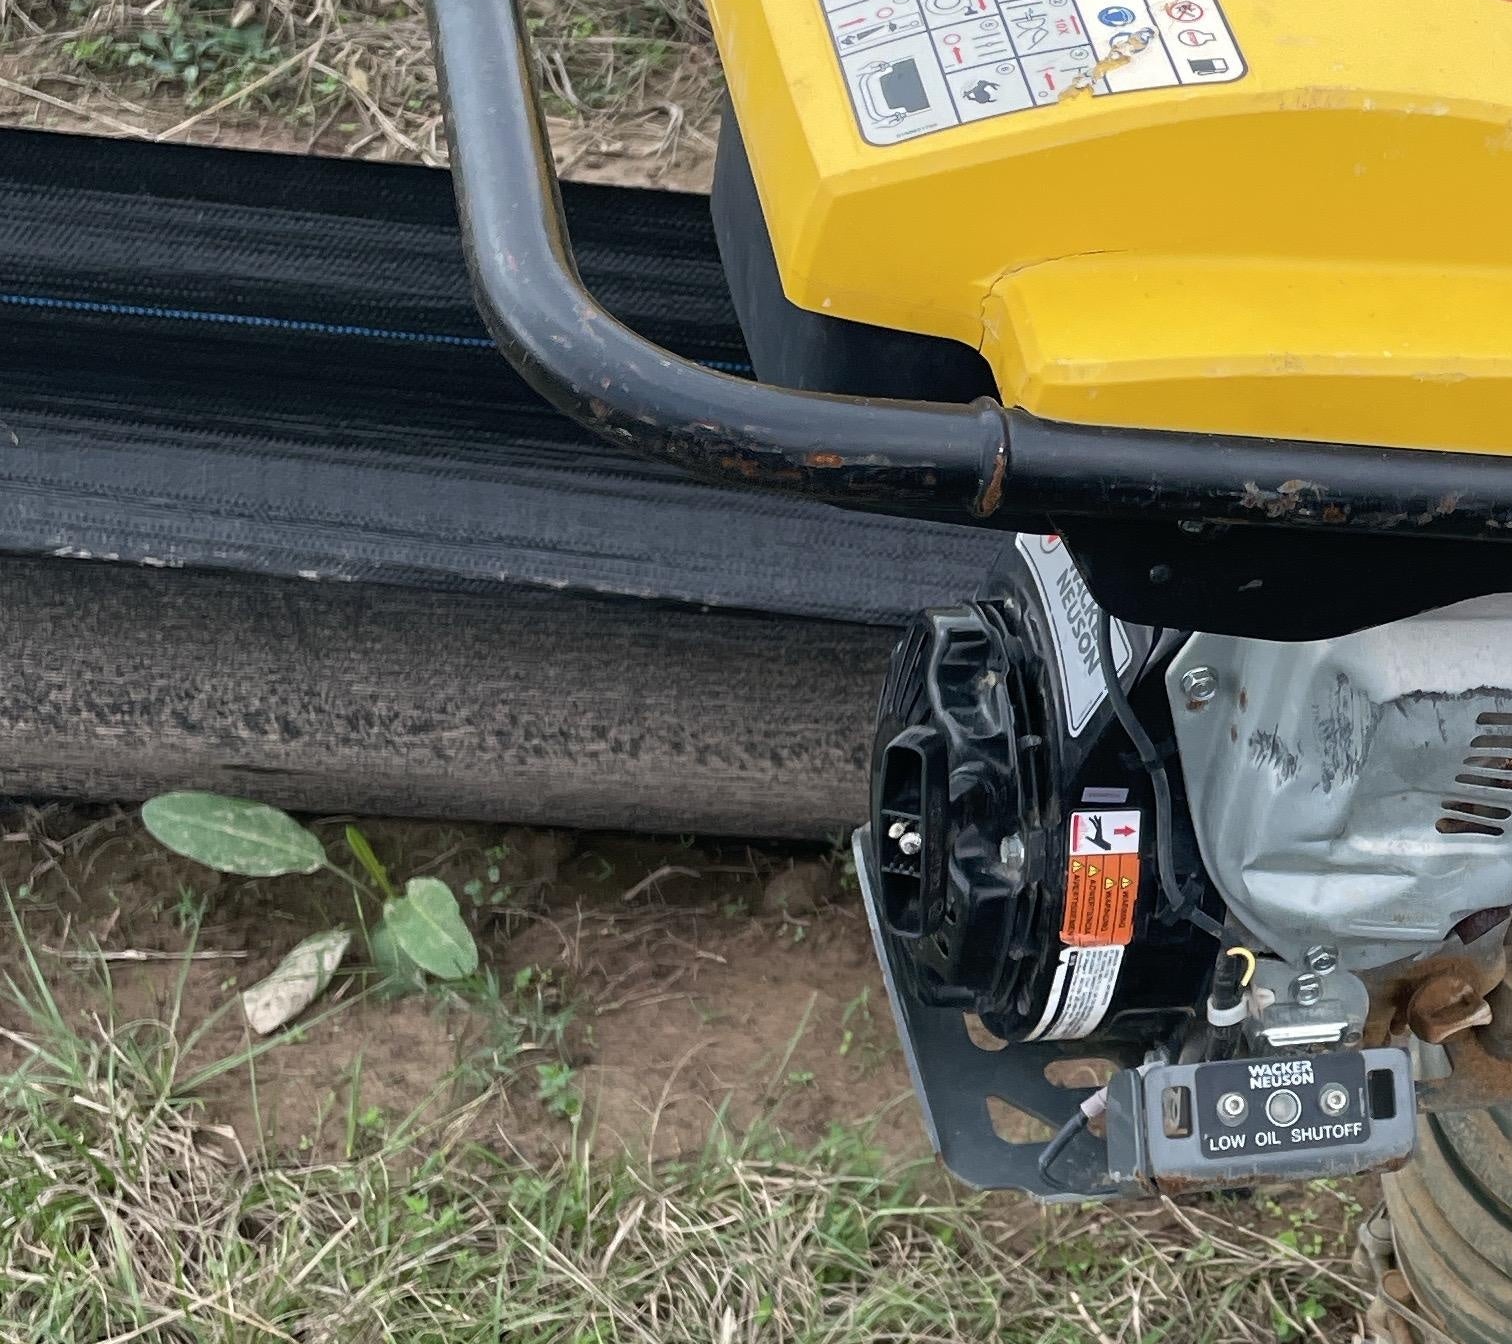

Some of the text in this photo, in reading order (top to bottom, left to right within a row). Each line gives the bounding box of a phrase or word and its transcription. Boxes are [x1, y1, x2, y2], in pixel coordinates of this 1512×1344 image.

[1054, 17, 1070, 37] 10X
[1056, 567, 1101, 677] NEUSON
[1248, 1060, 1313, 1078] WACKER
[1249, 1071, 1315, 1090] NEUSON
[1208, 1122, 1363, 1152] LOW OIL SHUTOFF
